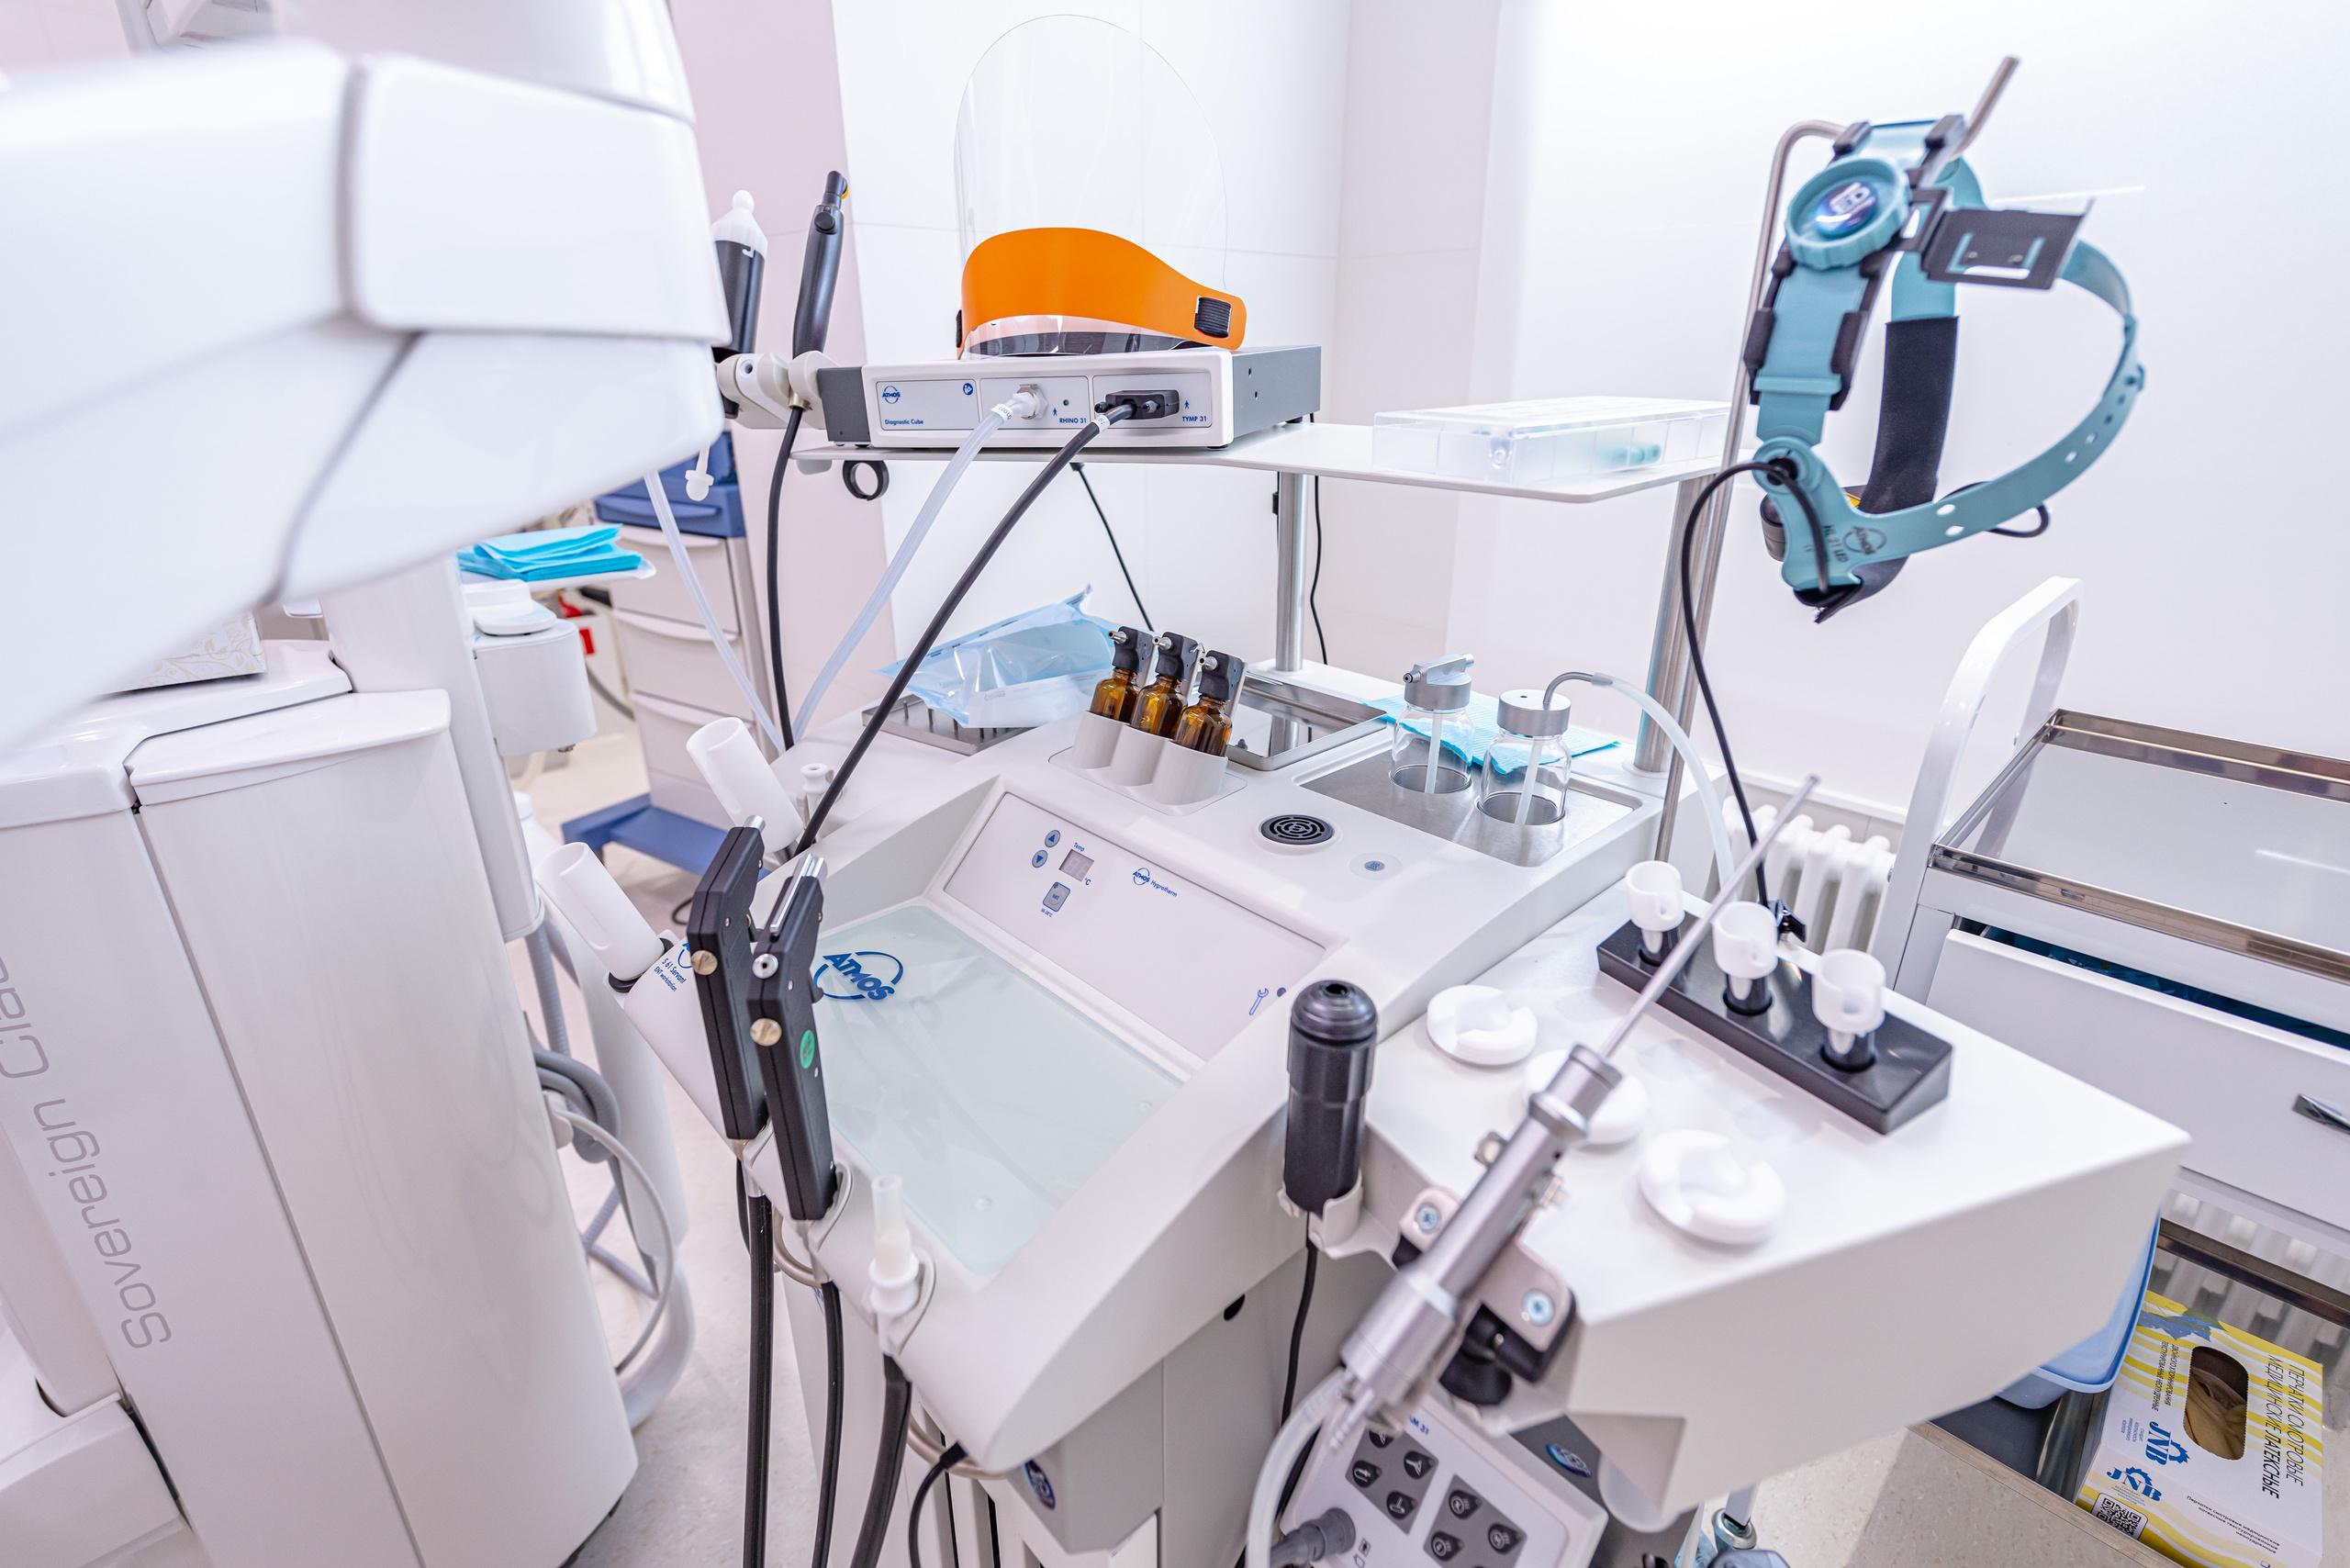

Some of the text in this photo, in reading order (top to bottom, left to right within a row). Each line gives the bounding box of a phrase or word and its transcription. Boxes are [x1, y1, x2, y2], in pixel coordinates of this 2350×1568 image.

[1073, 842, 1085, 852] Temp
[1132, 871, 1178, 898] ATMOS Hygrotherm
[654, 966, 677, 991] ENT workstation
[665, 961, 674, 969] 61
[670, 966, 687, 984] Servant
[822, 953, 895, 1000] ATMOS
[33, 1098, 172, 1350] Sovereign
[2145, 1421, 2171, 1465] JNB
[2262, 1355, 2283, 1499] МЕДИЦИНСКИЕ ЛАТЕКСНЫЕ
[2286, 1364, 2304, 1486] ПЕРЧАТКИ СМОТРОВЫЕ
[2107, 1467, 2162, 1501] JNB
[2187, 1495, 2280, 1546] Перчатки смотровые медицинские
